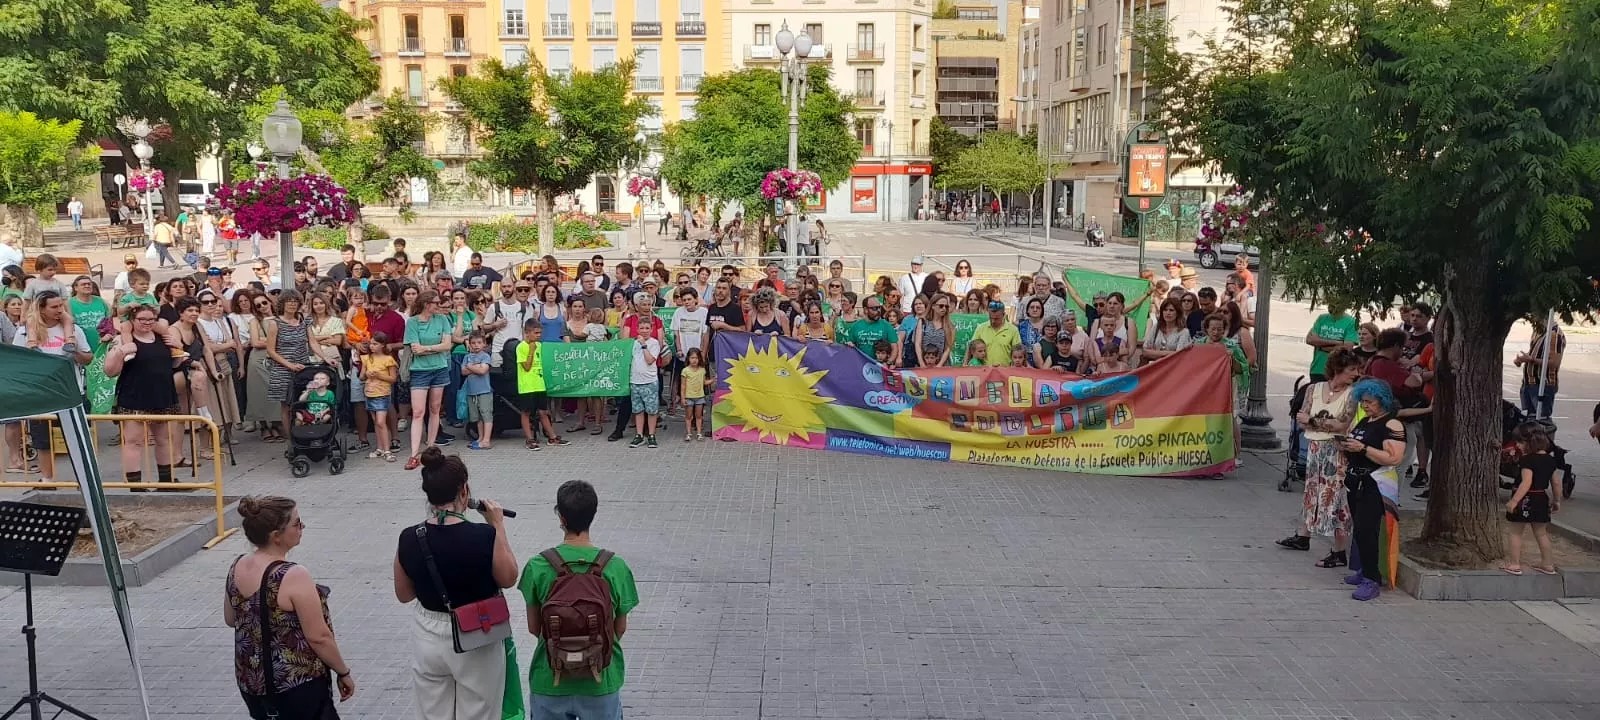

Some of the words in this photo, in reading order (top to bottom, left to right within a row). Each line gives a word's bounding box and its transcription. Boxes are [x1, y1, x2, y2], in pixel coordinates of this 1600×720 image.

[1006, 438, 1021, 449] LA
[1025, 437, 1077, 449] NUESTRA
[1113, 434, 1154, 449] TODOS
[1158, 430, 1224, 447] PINTAMOS
[967, 450, 1017, 463] Plataforma
[1020, 456, 1031, 465] en
[1034, 453, 1071, 467] Defensa
[1075, 455, 1085, 469] de
[1089, 453, 1097, 468] la
[1100, 452, 1136, 469] Escuela
[1138, 451, 1174, 469] Pública
[1177, 449, 1213, 466] HUESCA
